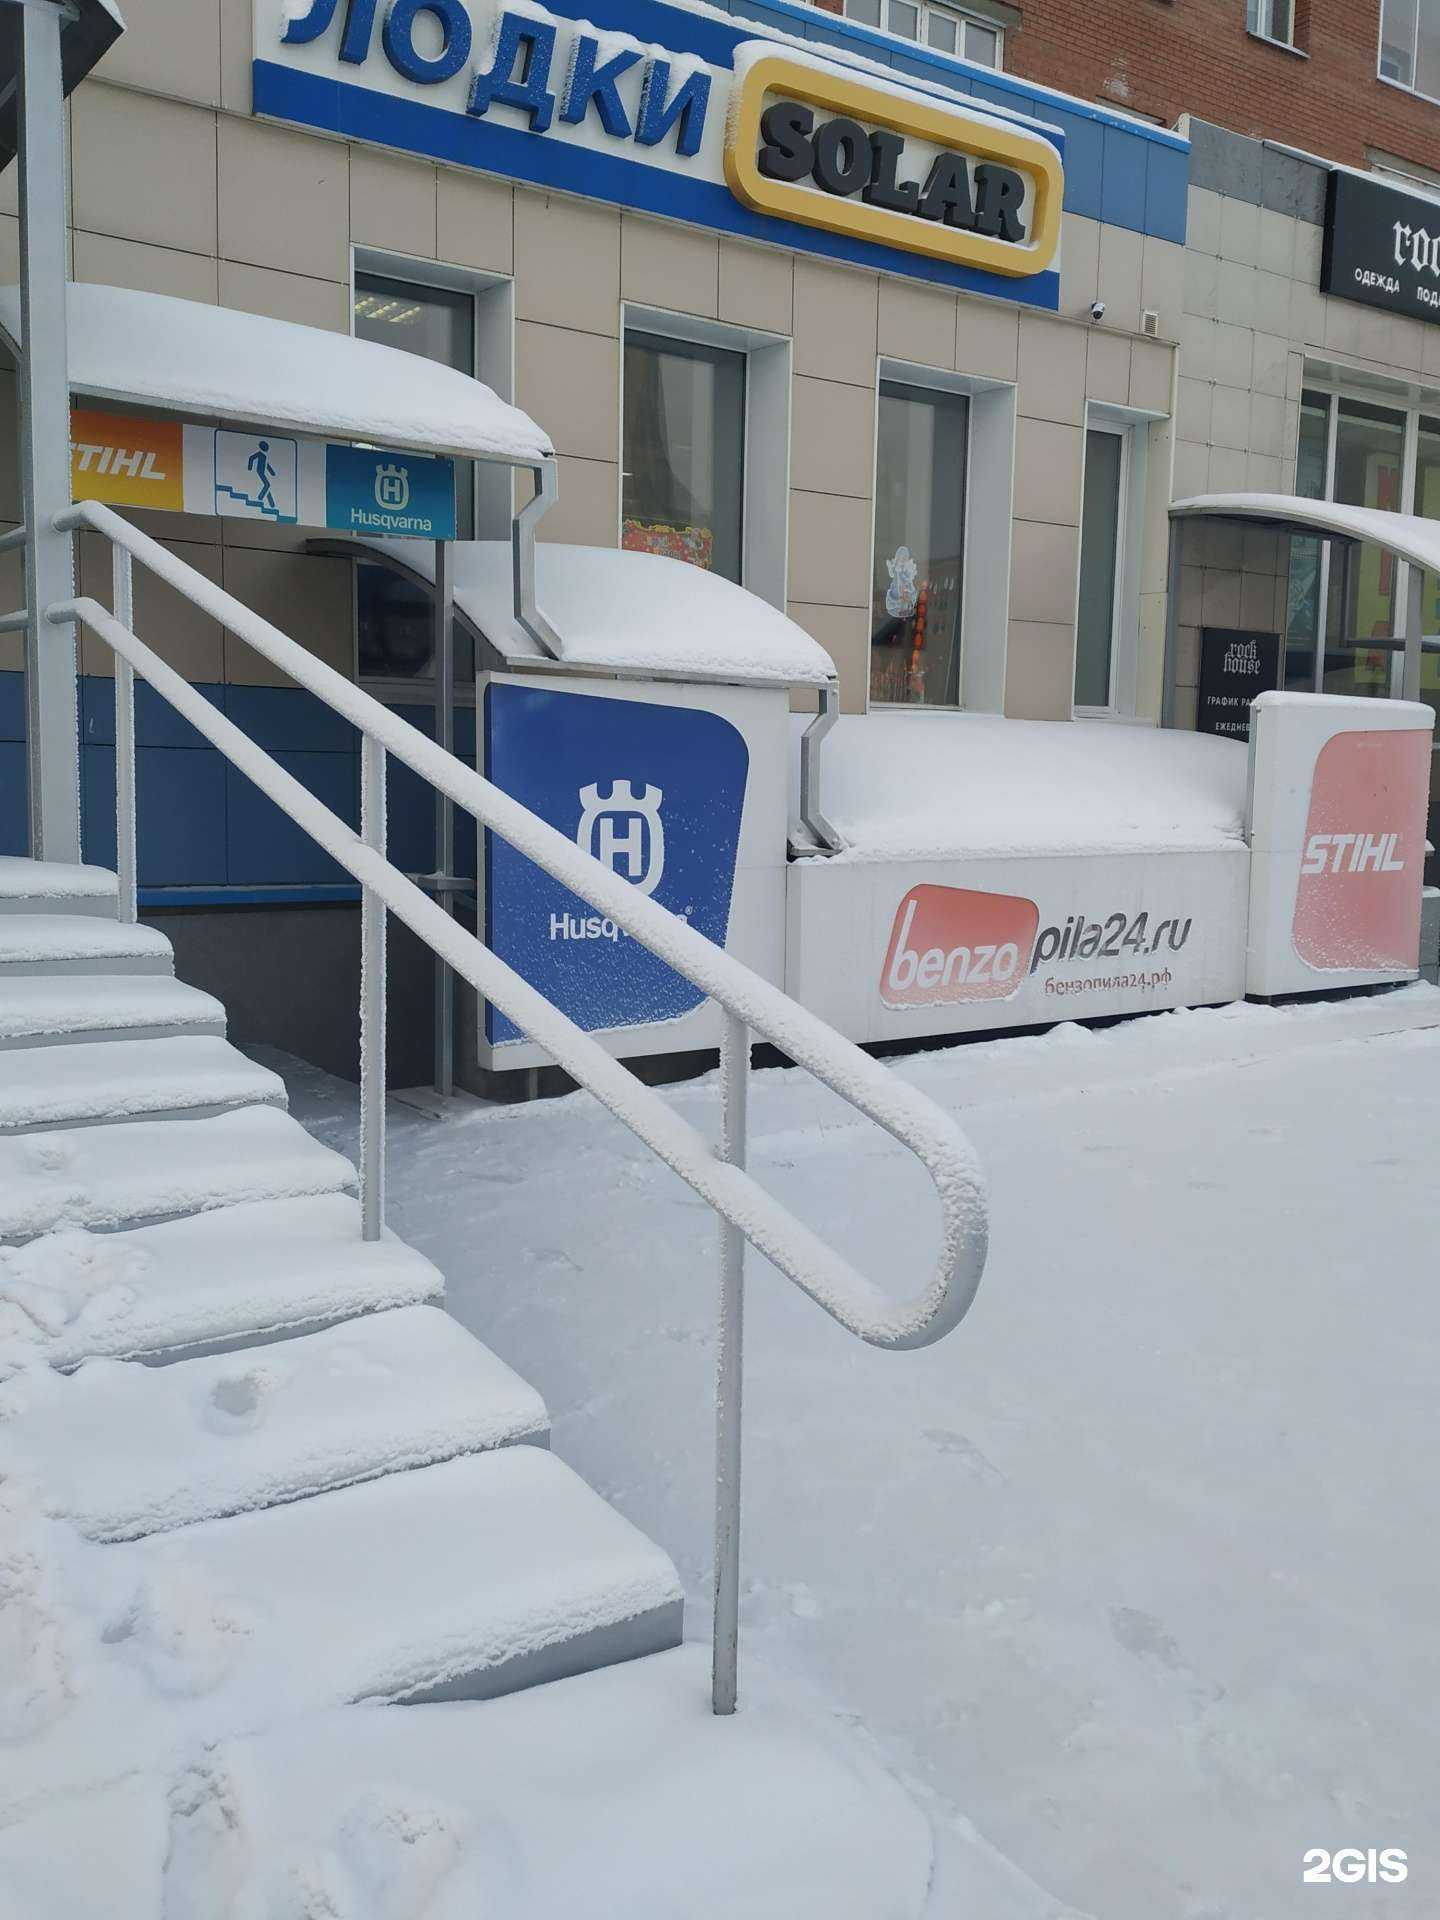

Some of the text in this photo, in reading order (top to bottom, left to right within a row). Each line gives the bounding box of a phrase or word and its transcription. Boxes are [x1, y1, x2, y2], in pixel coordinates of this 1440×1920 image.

[280, 0, 713, 157] ЛОДКИ
[757, 101, 1026, 243] SOLAR
[1354, 267, 1440, 309] ОДЕЖДА ПОД
[70, 441, 167, 480] TIHL
[350, 507, 433, 533] Husqvarna
[1222, 651, 1261, 675] house
[1229, 639, 1257, 660] rock
[1207, 696, 1240, 707] ГРАФИК
[1301, 833, 1404, 874] STIHL
[1044, 967, 1173, 995] бензопила24.рф
